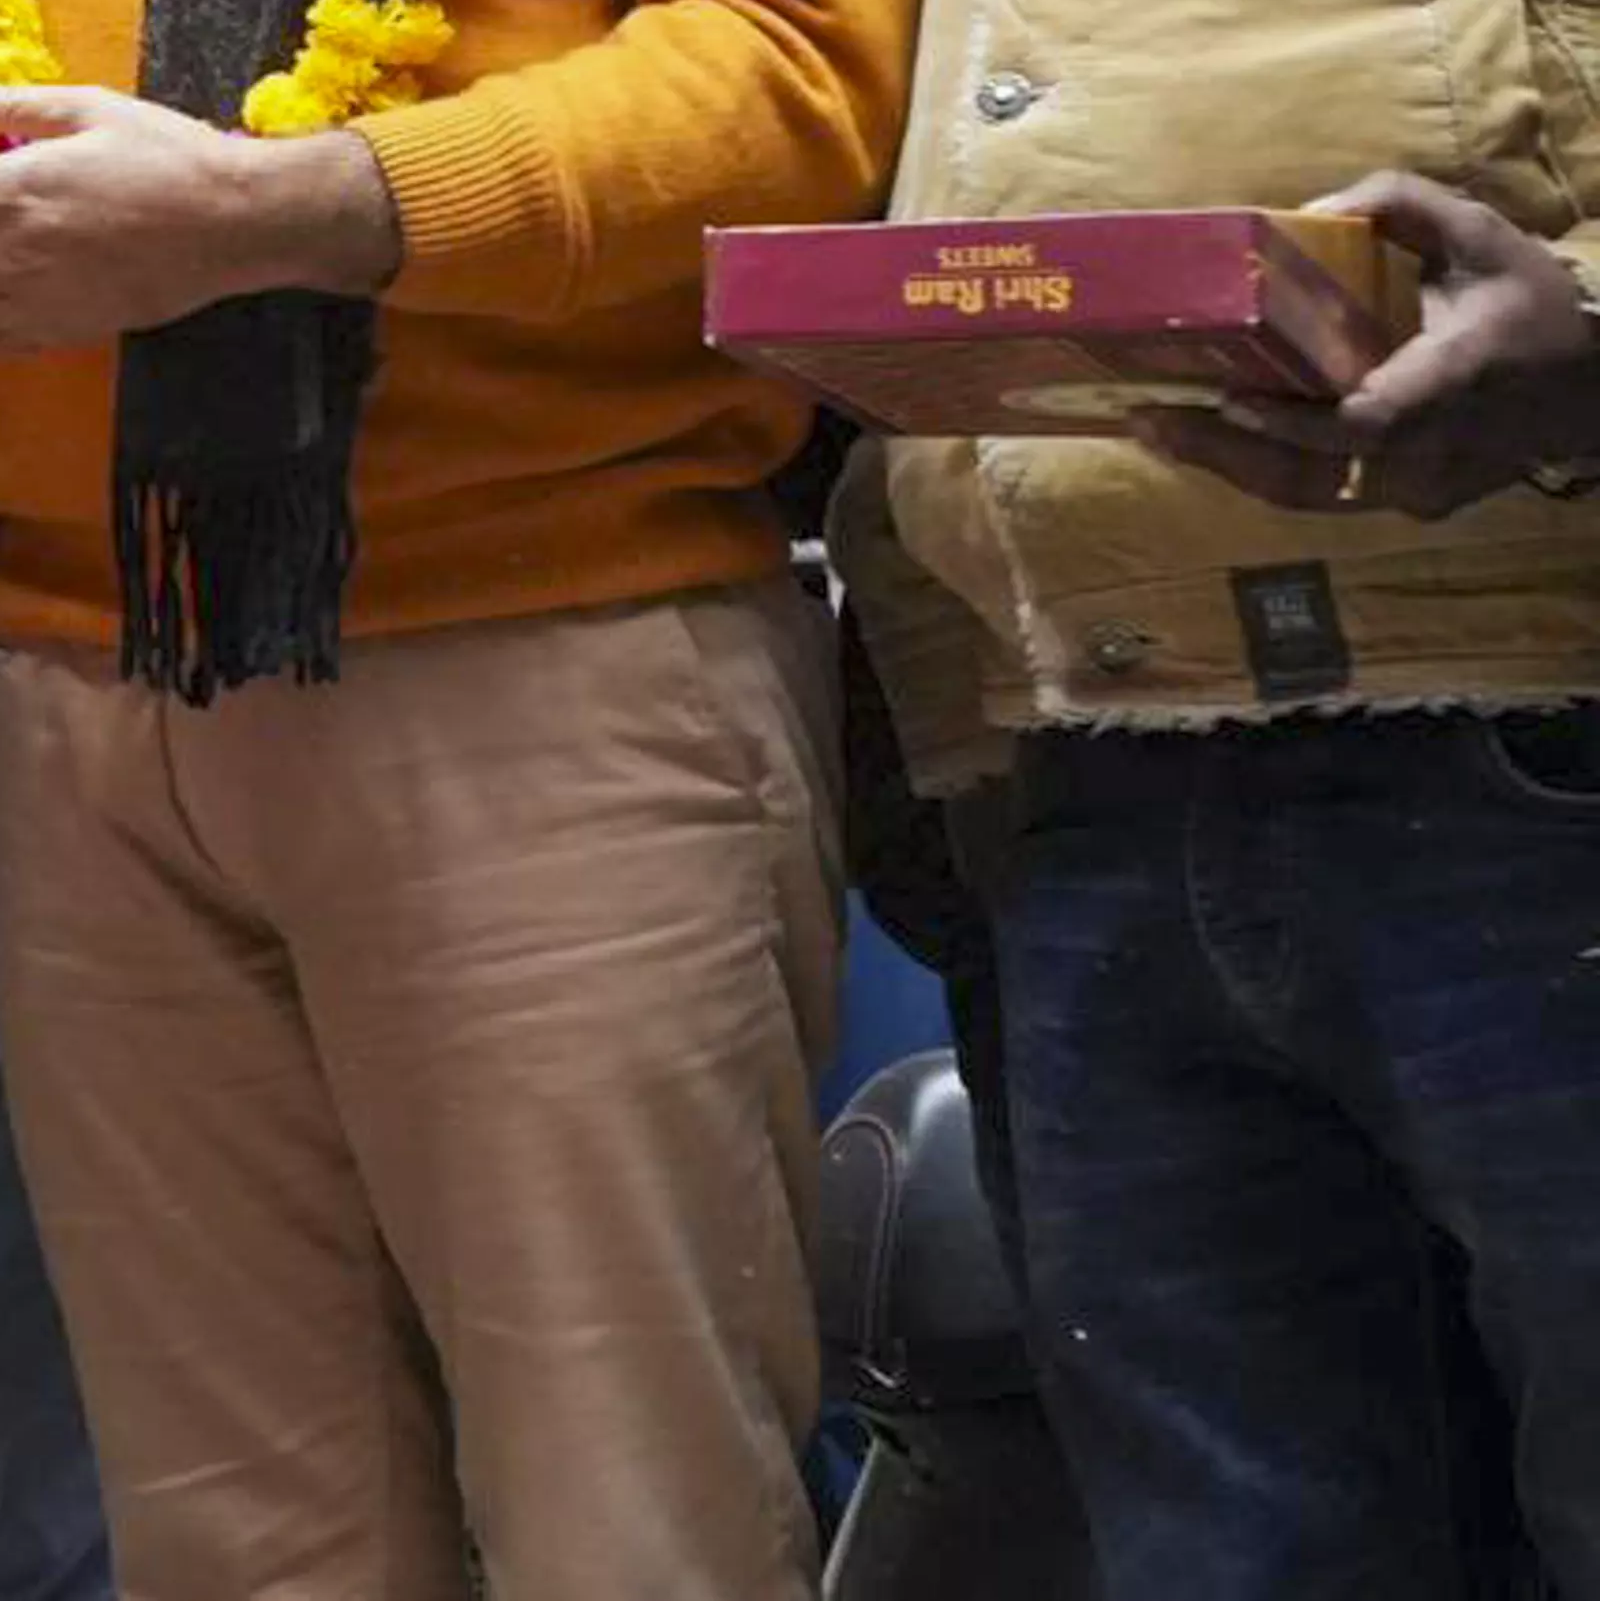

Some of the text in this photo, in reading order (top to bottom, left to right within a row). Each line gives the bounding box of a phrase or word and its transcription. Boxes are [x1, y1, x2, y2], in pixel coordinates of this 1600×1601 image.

[937, 244, 1036, 268] SWEETS
[903, 277, 1073, 314] Shri Ram
